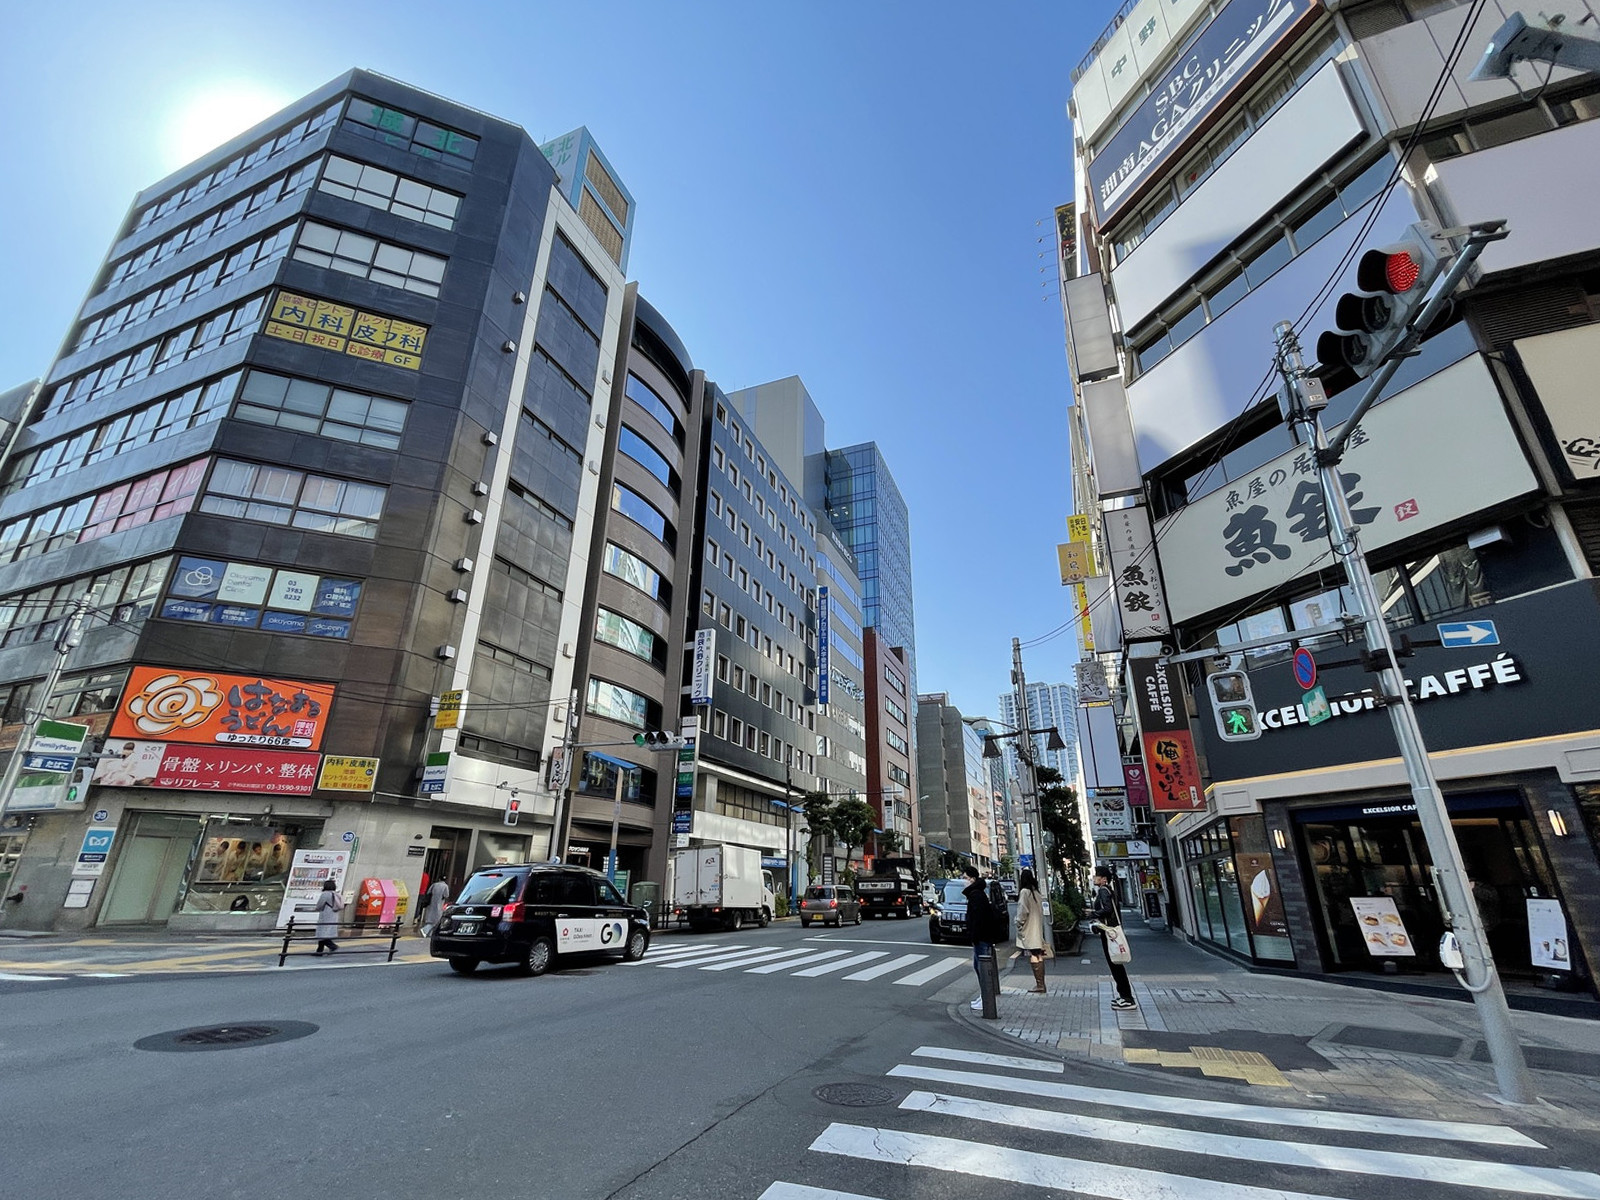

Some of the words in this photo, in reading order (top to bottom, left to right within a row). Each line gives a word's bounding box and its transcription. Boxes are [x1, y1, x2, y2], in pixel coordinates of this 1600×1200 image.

[1155, 55, 1200, 108] SBC
[279, 306, 344, 332] 内科
[393, 354, 412, 366] 6F
[1225, 424, 1370, 513] 魚屋の居屋
[228, 680, 322, 718] はなまる
[1145, 675, 1163, 712] CAFFÉ
[220, 709, 292, 737] うどん
[34, 740, 77, 752] FamilyMart
[266, 784, 312, 792] 03-3590-9301
[1362, 805, 1401, 814] EXCELSIOR
